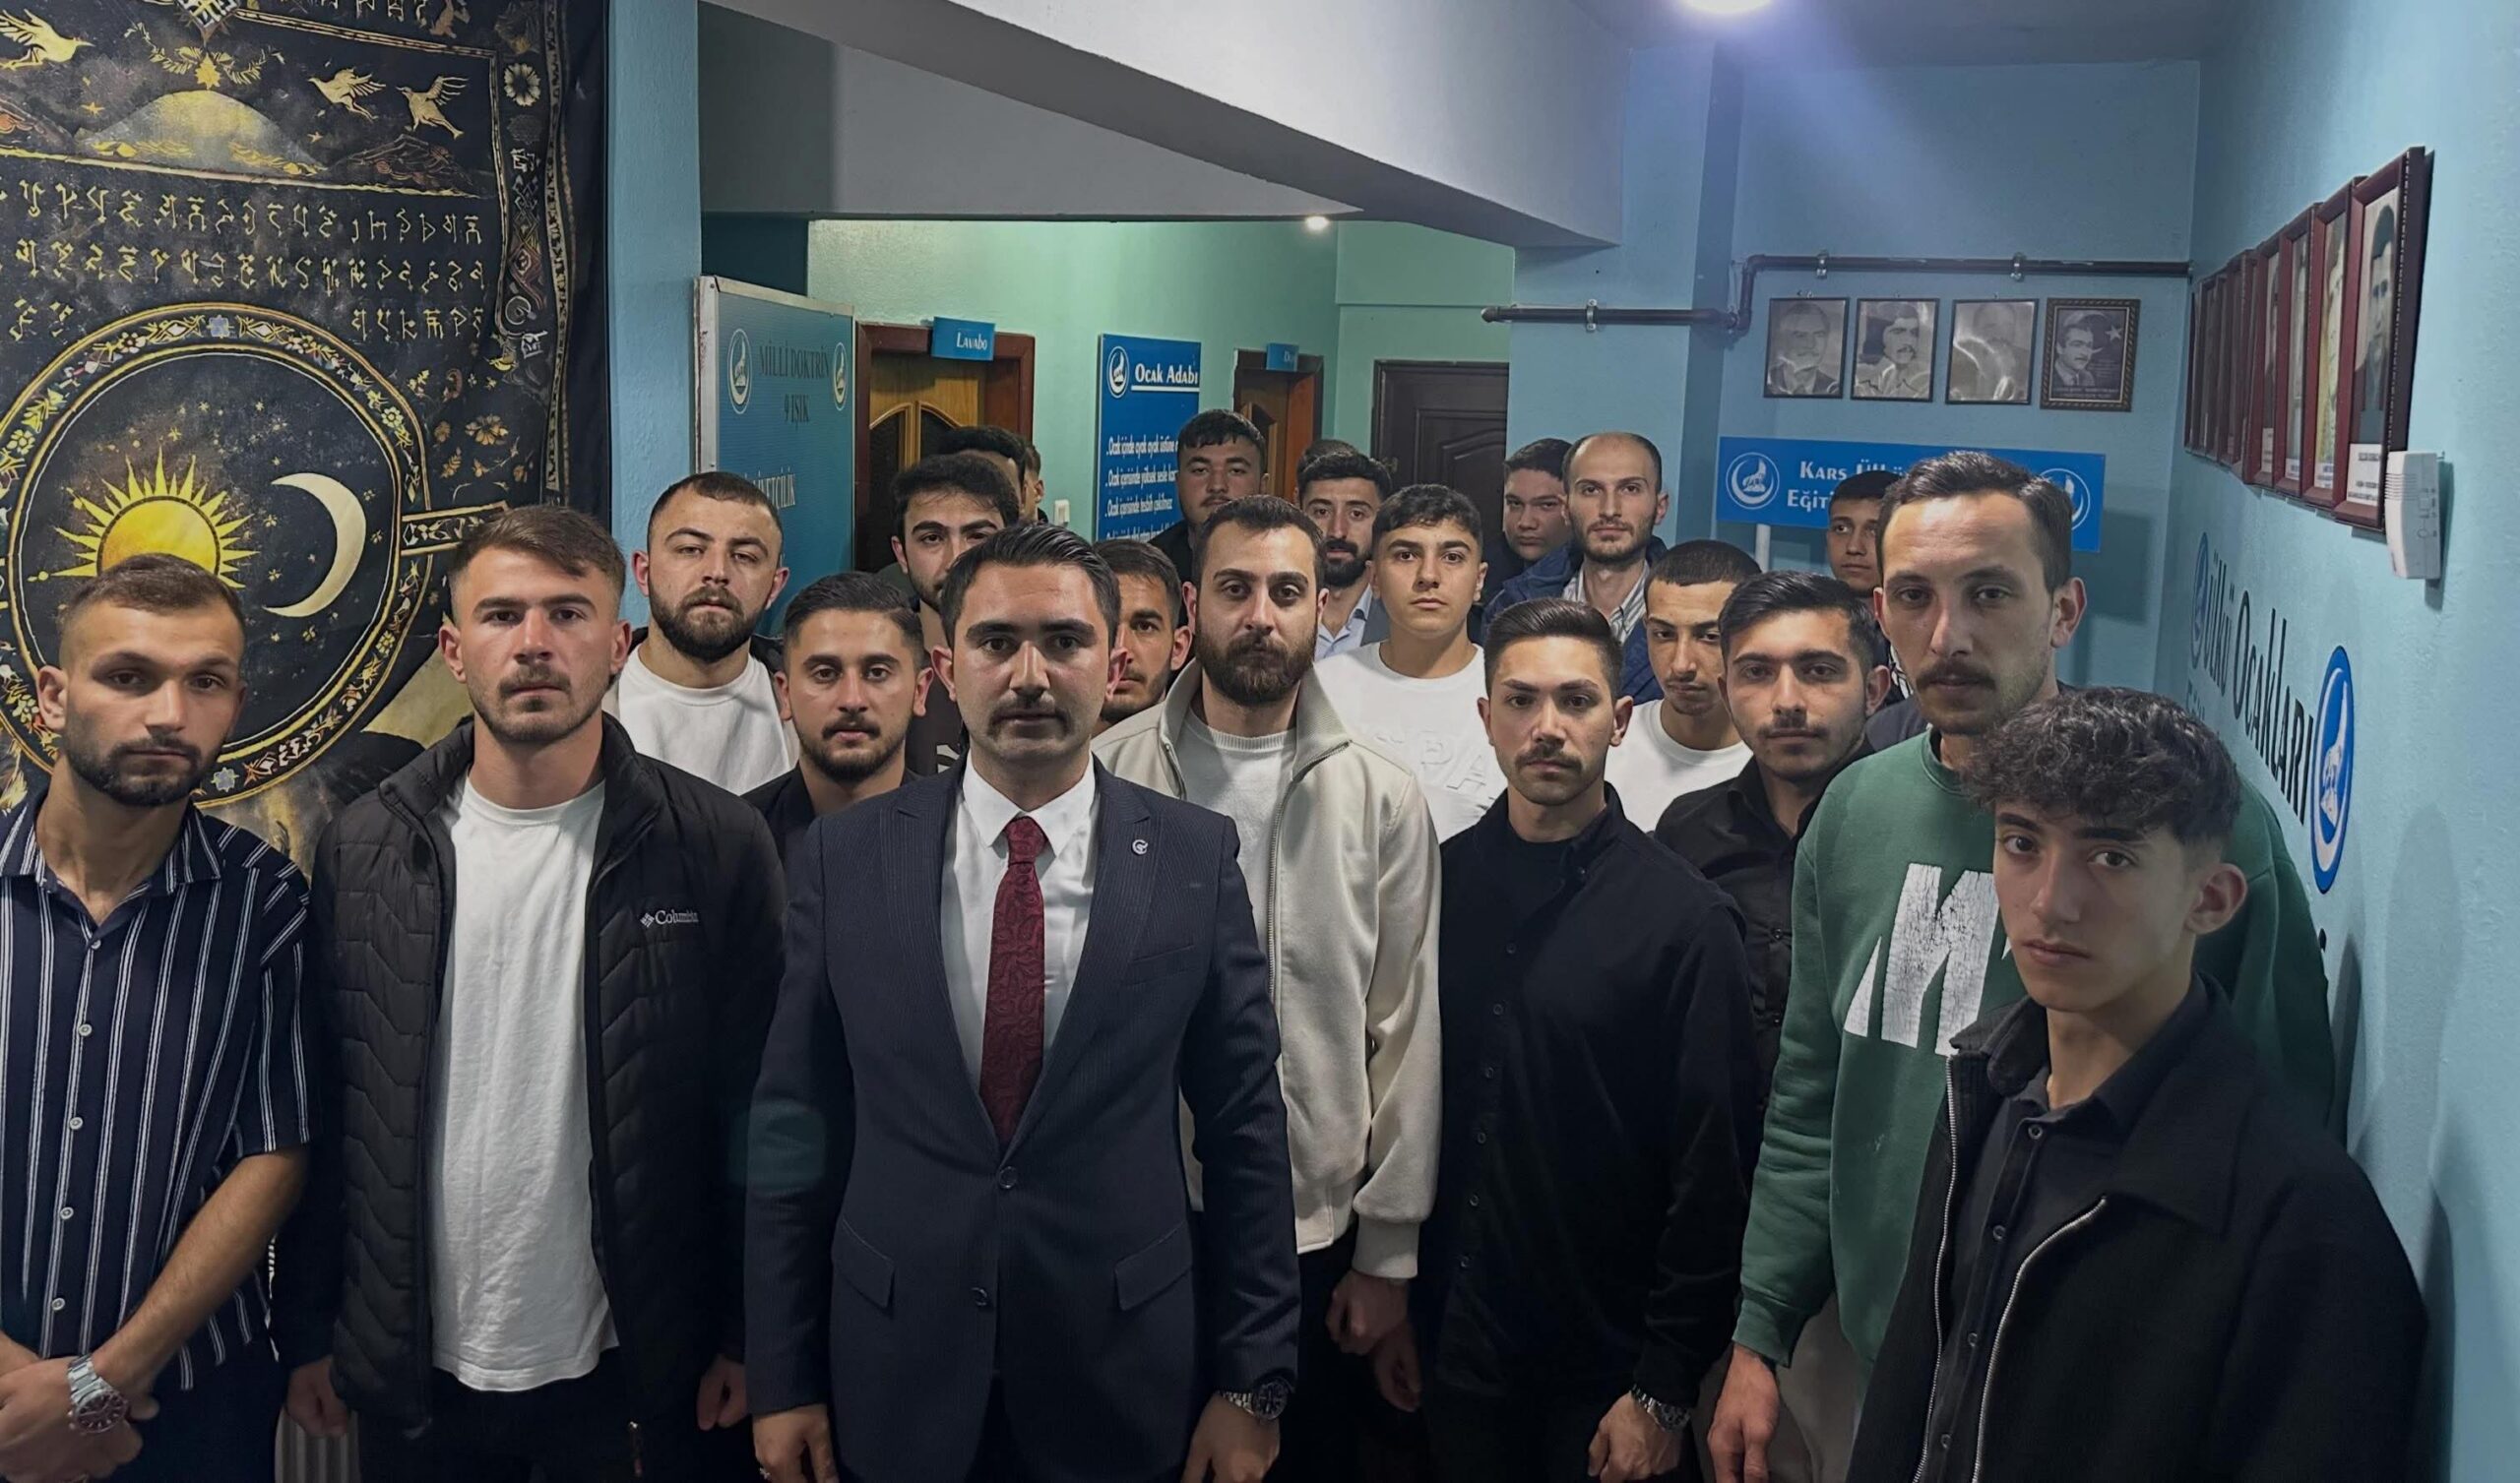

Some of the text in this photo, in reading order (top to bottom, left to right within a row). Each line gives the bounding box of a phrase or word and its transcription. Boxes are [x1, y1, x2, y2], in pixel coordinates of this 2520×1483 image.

[957, 331, 987, 350] Lavabo
[760, 339, 829, 380] MİLLİ DOKTRİN
[1135, 362, 1198, 385] Ocak Adabı
